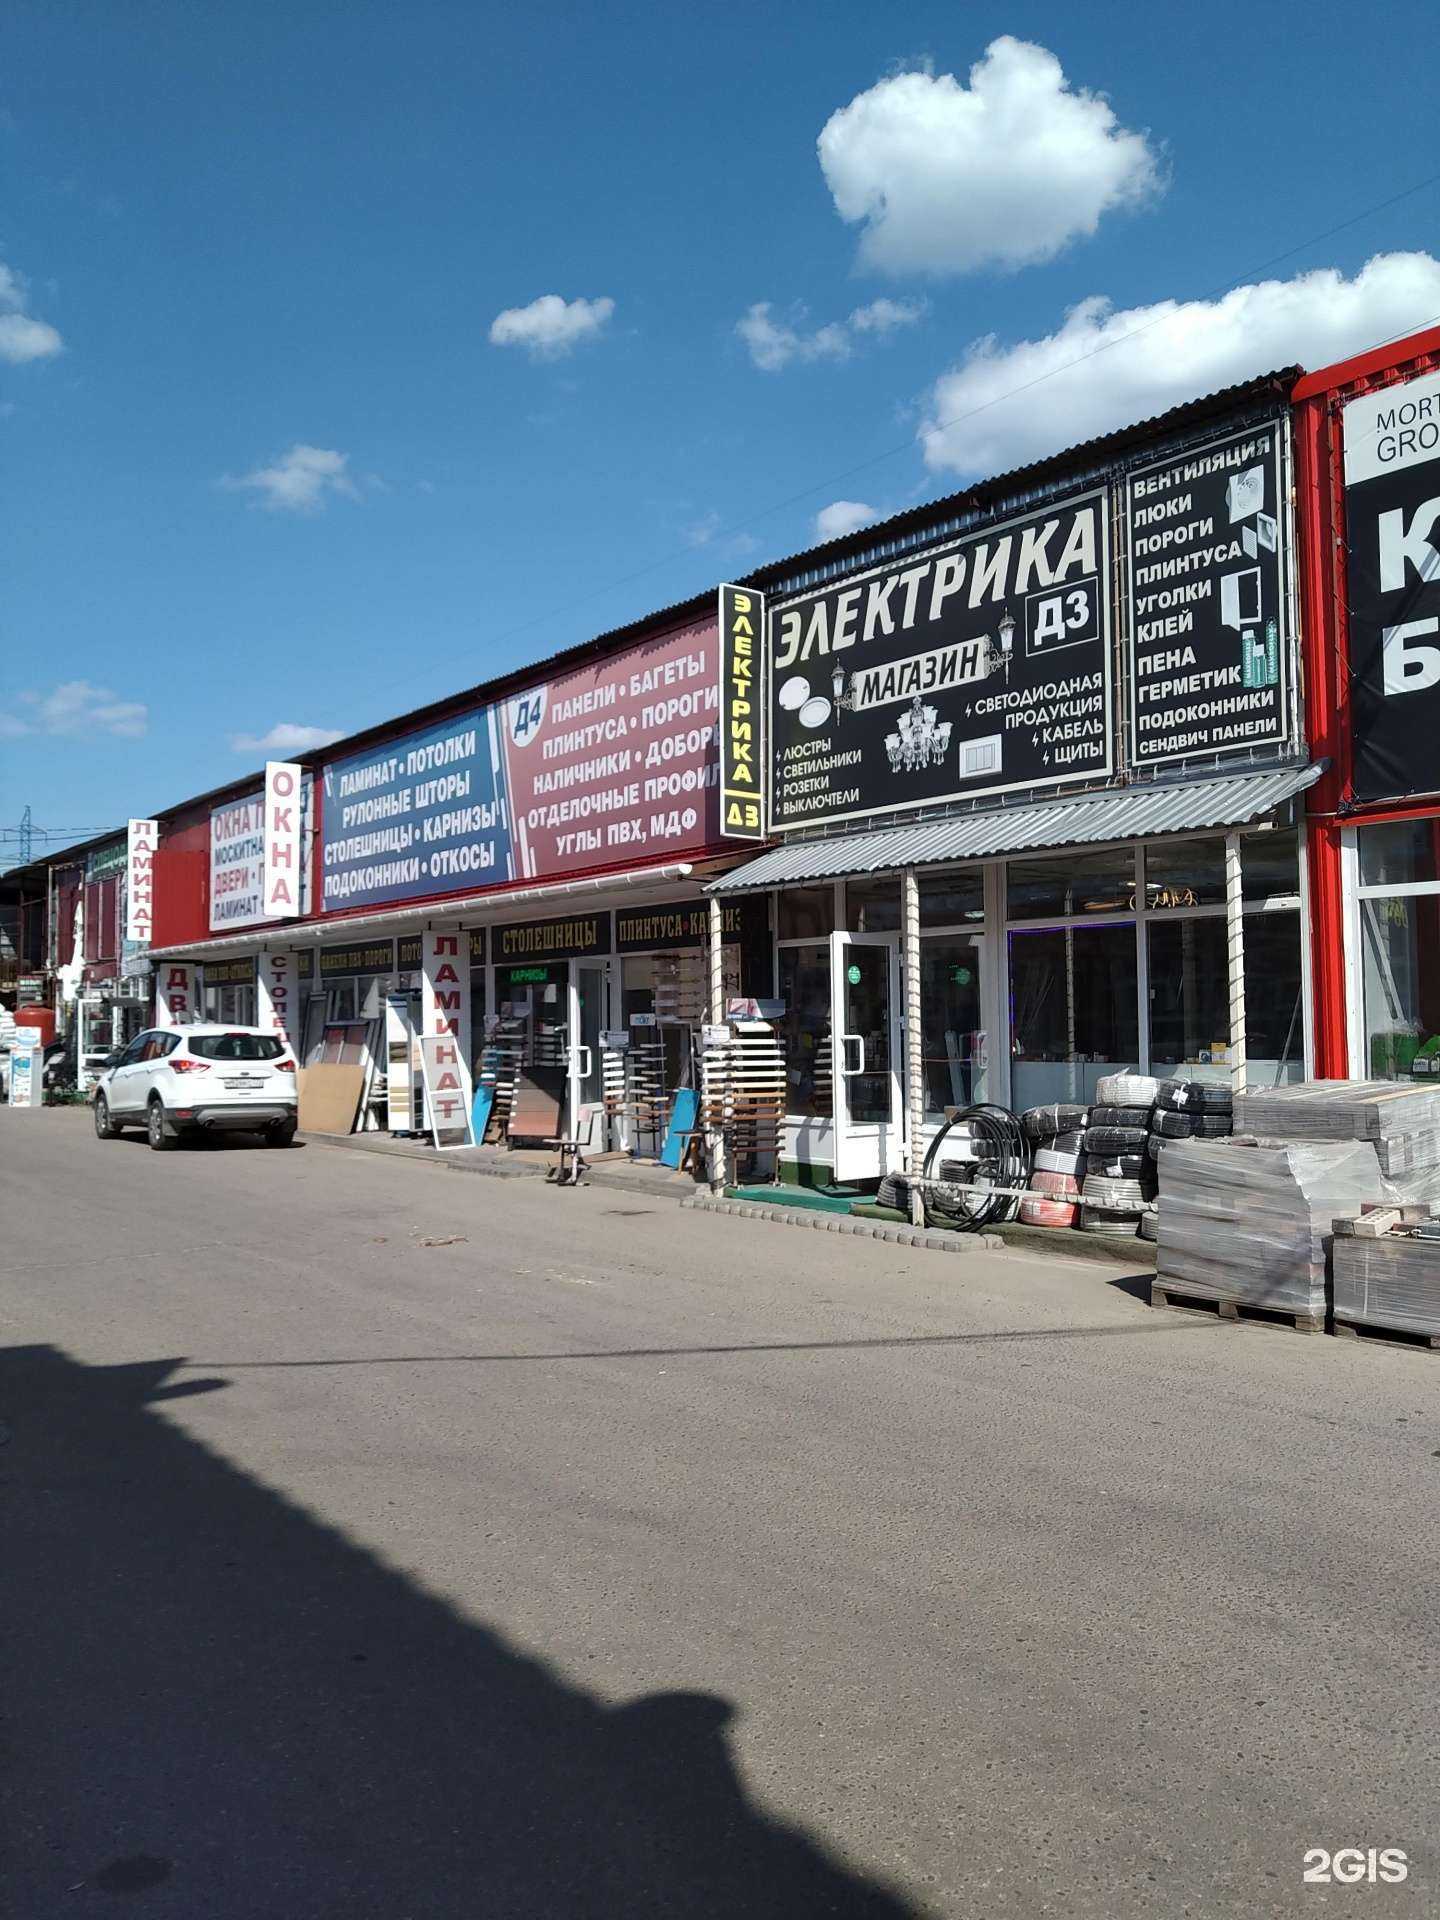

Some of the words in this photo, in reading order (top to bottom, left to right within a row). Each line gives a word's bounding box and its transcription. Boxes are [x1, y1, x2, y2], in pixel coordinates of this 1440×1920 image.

[1378, 423, 1438, 462] GRO
[1134, 436, 1270, 500] ВЕНТИЛЯЦИЯ
[1134, 494, 1192, 529] ЛЮКИ
[1136, 517, 1213, 557] ПОРОГИ
[1136, 541, 1242, 587] ПЛИНТУСА
[775, 508, 1098, 670] ЭЛЕКТРИКА
[1136, 580, 1212, 616] УГОЛКИ
[1137, 610, 1193, 643] КЛЕЙ
[862, 642, 979, 706] МАГАЗИН
[1138, 645, 1196, 677] ПЕНА
[551, 686, 616, 724] ПАНЕЛИ
[629, 650, 706, 695] БАГЕТЫ
[731, 594, 754, 783] ЭЛЕКТРИКА
[975, 672, 1102, 716] СВЕТОДИОДНАЯ
[1138, 664, 1242, 704] ГЕРМЕТИК
[513, 694, 542, 740] Д4
[542, 718, 628, 760] ПЛИНТУСА
[641, 685, 718, 730] ПОРОГИ
[1005, 698, 1102, 730] ПРОДУКЦИЯ
[1139, 690, 1274, 732] ПОДОКОННИКИ
[783, 738, 832, 760] ЛЮСТРЫ
[1042, 720, 1103, 744] КАБЕЛЬ
[1139, 731, 1208, 755] СЕНДВИЧ
[1212, 718, 1277, 742] ПАНЕЛИ
[340, 758, 397, 798] ЛАМИНАТ
[407, 730, 476, 774] ПОТОЛКИ
[533, 749, 631, 795] НАЛИЧНИКИ
[783, 750, 862, 779] СВЕТИЛЬНИКИ
[1054, 741, 1103, 765] ЩИТЫ
[342, 788, 411, 829] РУЛОННЫЕ
[415, 770, 470, 807] ШТОРЫ
[783, 776, 829, 797] РОЗЕТКИ
[783, 788, 860, 816] ВЫКЛЮЧТЕЛИ
[215, 805, 251, 842] ОКНА
[528, 784, 640, 830] ОТДЕЛОЧНЫЕ
[215, 837, 265, 865] МОСКИТНА
[270, 772, 293, 905] ОКНА
[324, 822, 413, 867] СТОЛЕШНИЦЫ
[423, 802, 497, 843] КАРНИЗЫ
[556, 822, 602, 857] УГЛЫ
[607, 812, 647, 845] ПВХ,
[650, 807, 698, 841] МДФ
[133, 822, 152, 938] ЛАМИНАТ
[215, 868, 249, 898] ДВЕРИ
[324, 856, 419, 899] ПОДОКОННИКИ
[430, 840, 495, 877] ОТКОСЫ
[214, 895, 258, 922] ЛАМИНАТ
[619, 914, 682, 942] ПЛИНТУСА
[401, 943, 422, 961] ПОТО
[502, 921, 597, 954] СТОЛЕШНИЦЫ
[432, 936, 461, 1119] ЛАМИНАТ
